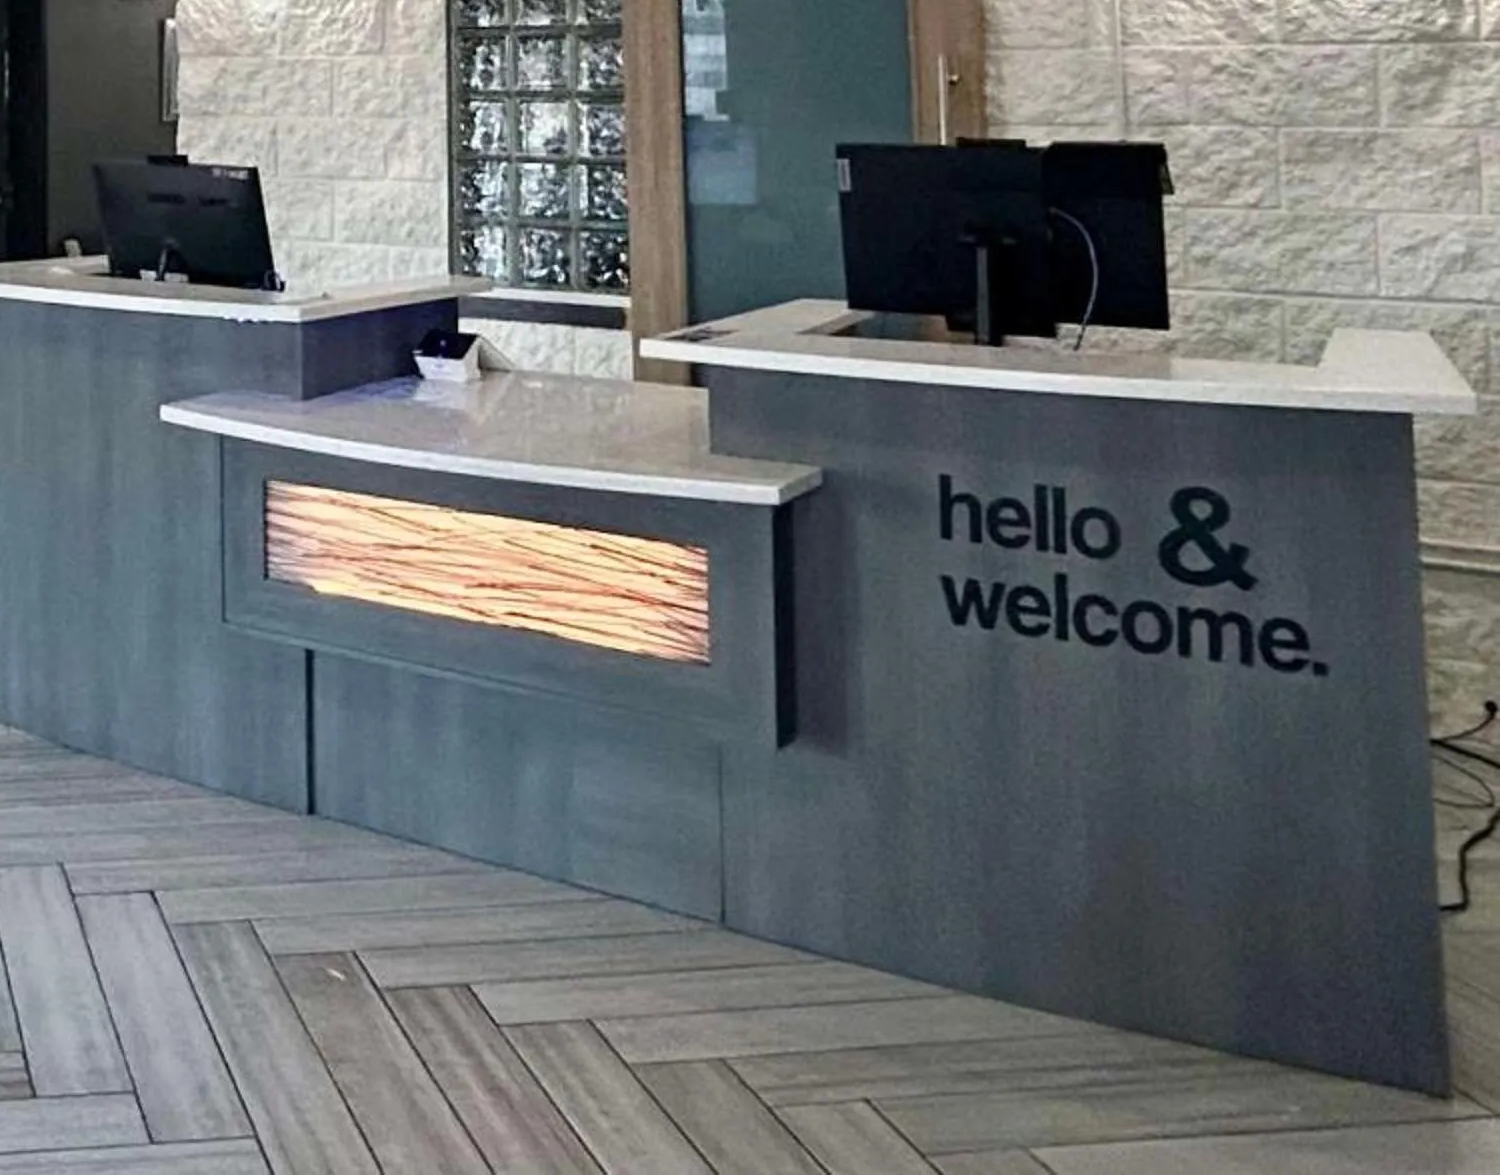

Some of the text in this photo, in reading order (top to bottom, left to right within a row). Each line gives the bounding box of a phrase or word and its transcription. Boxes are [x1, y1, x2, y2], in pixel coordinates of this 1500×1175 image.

[938, 473, 1259, 591] hello &
[940, 573, 1330, 677] welcome.
